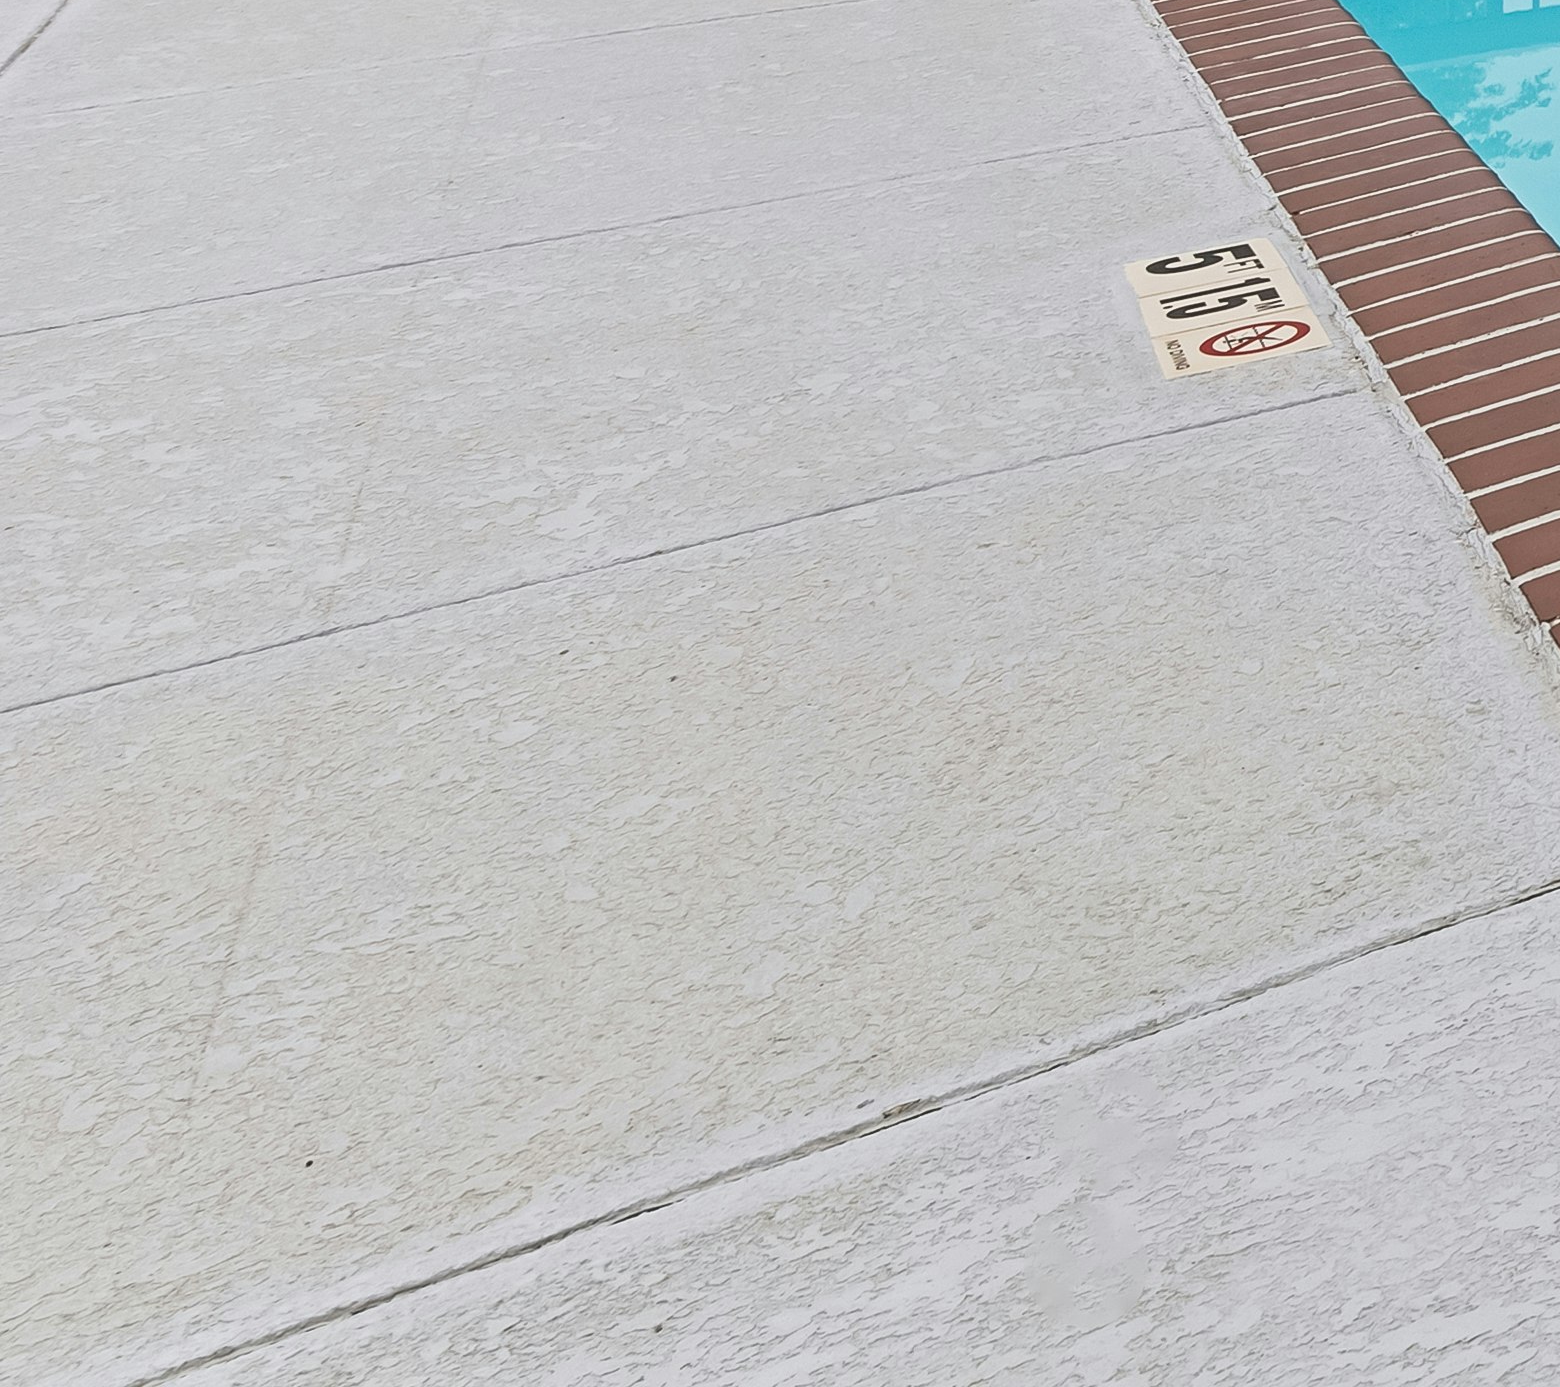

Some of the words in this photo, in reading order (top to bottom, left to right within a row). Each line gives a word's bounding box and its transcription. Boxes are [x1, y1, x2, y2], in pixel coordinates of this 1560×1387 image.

[1145, 243, 1257, 275] 5
[1166, 339, 1181, 351] NO
[1170, 349, 1190, 371] DIVING
